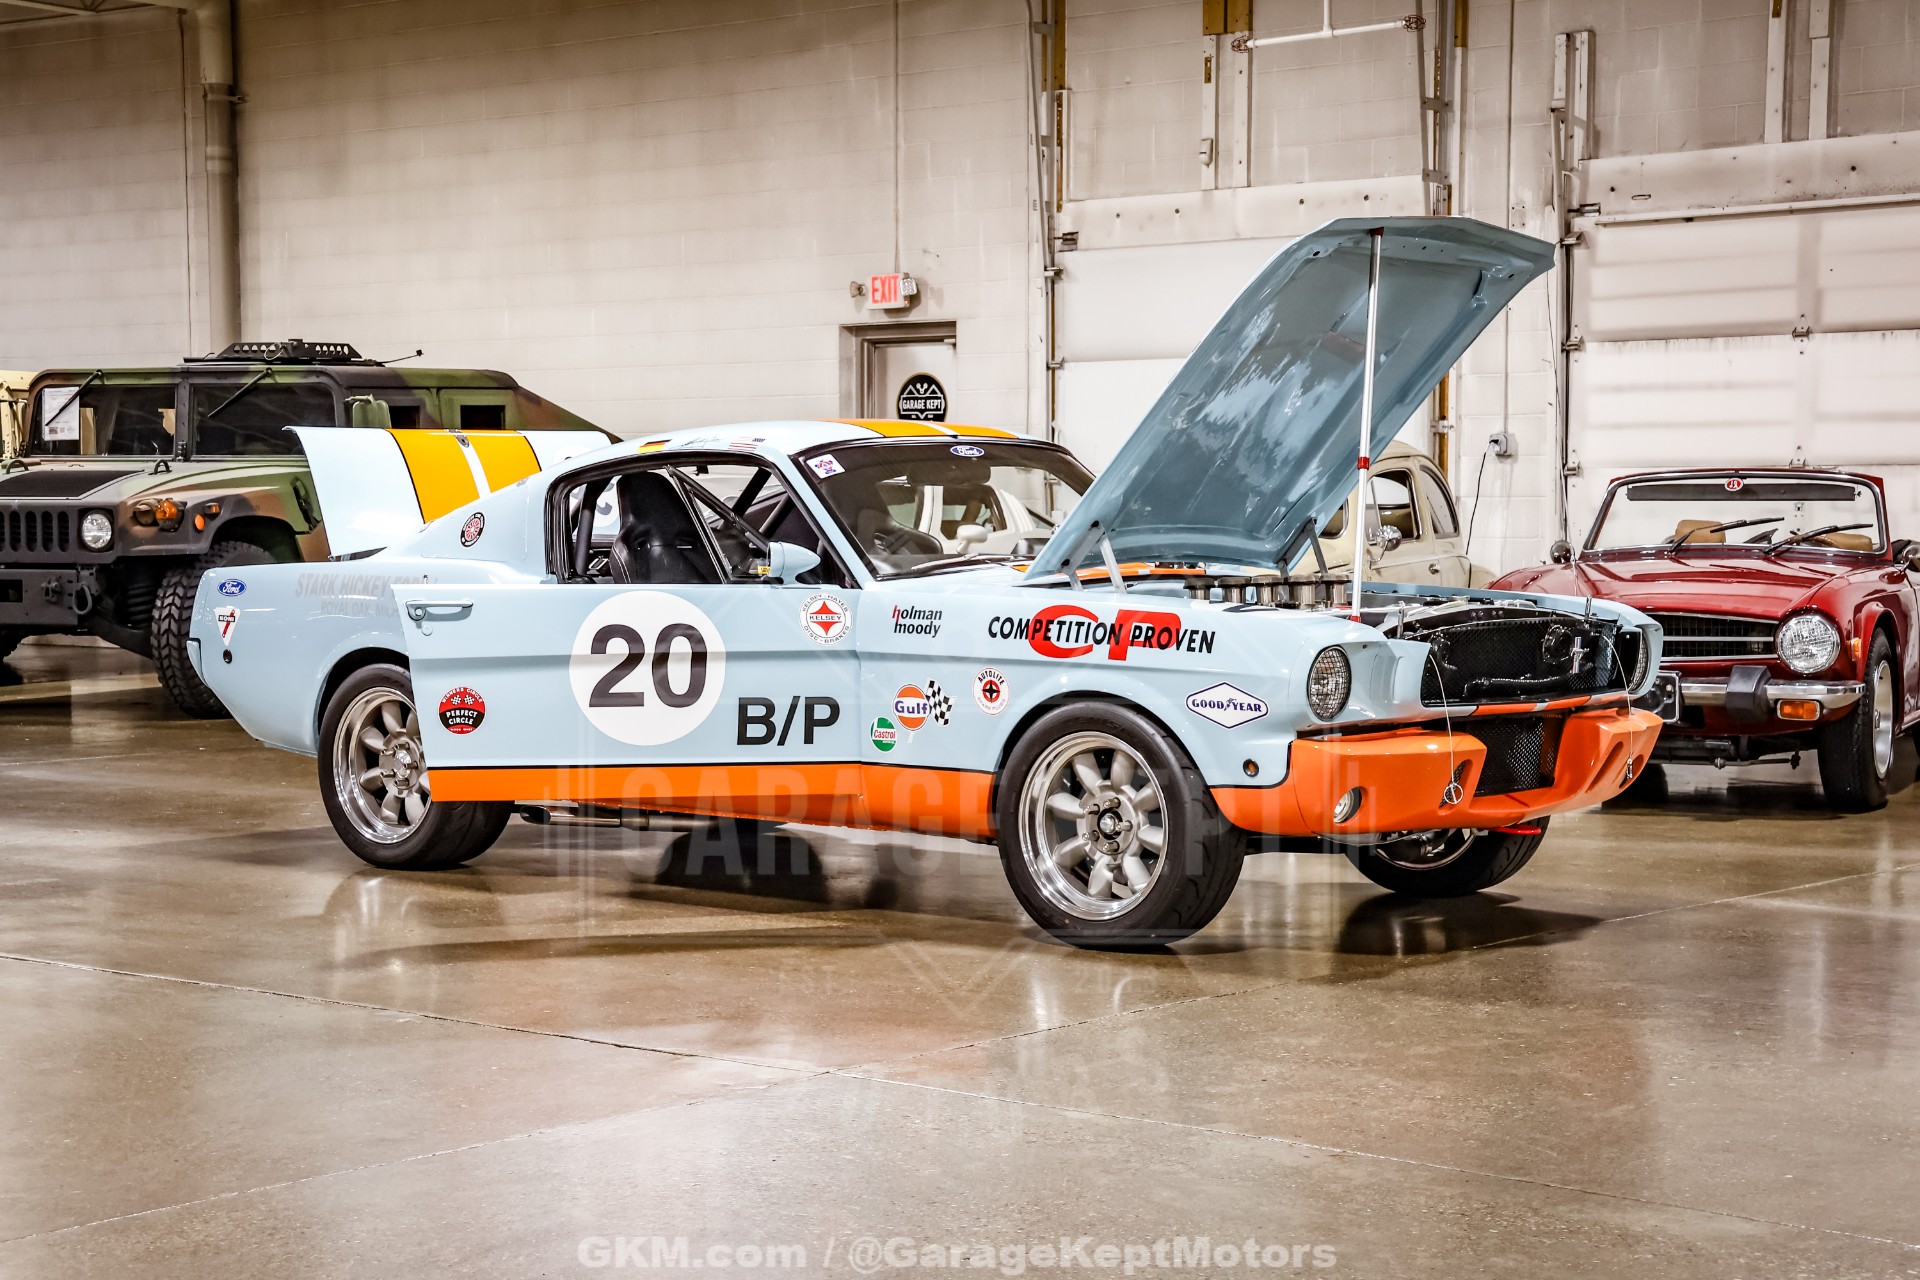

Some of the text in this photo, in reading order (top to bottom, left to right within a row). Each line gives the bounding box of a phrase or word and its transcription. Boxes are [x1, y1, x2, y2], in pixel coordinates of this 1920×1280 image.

[871, 274, 899, 304] EXIT
[902, 399, 942, 410] GARAGE KEPT
[221, 580, 242, 594] Ford
[295, 573, 391, 599] STARK HICKEY
[320, 600, 348, 616] ROYAL
[892, 604, 943, 622] holman
[893, 621, 941, 639] moody
[987, 614, 1217, 655] COMPETITION PROVEN
[588, 623, 708, 708] 20
[977, 670, 1005, 685] AUTOLITE
[445, 709, 478, 718] PERFECT
[894, 700, 928, 715] Gulf
[448, 717, 474, 725] CIRCLE
[737, 695, 841, 746] B/P
[873, 729, 896, 739] Castrol
